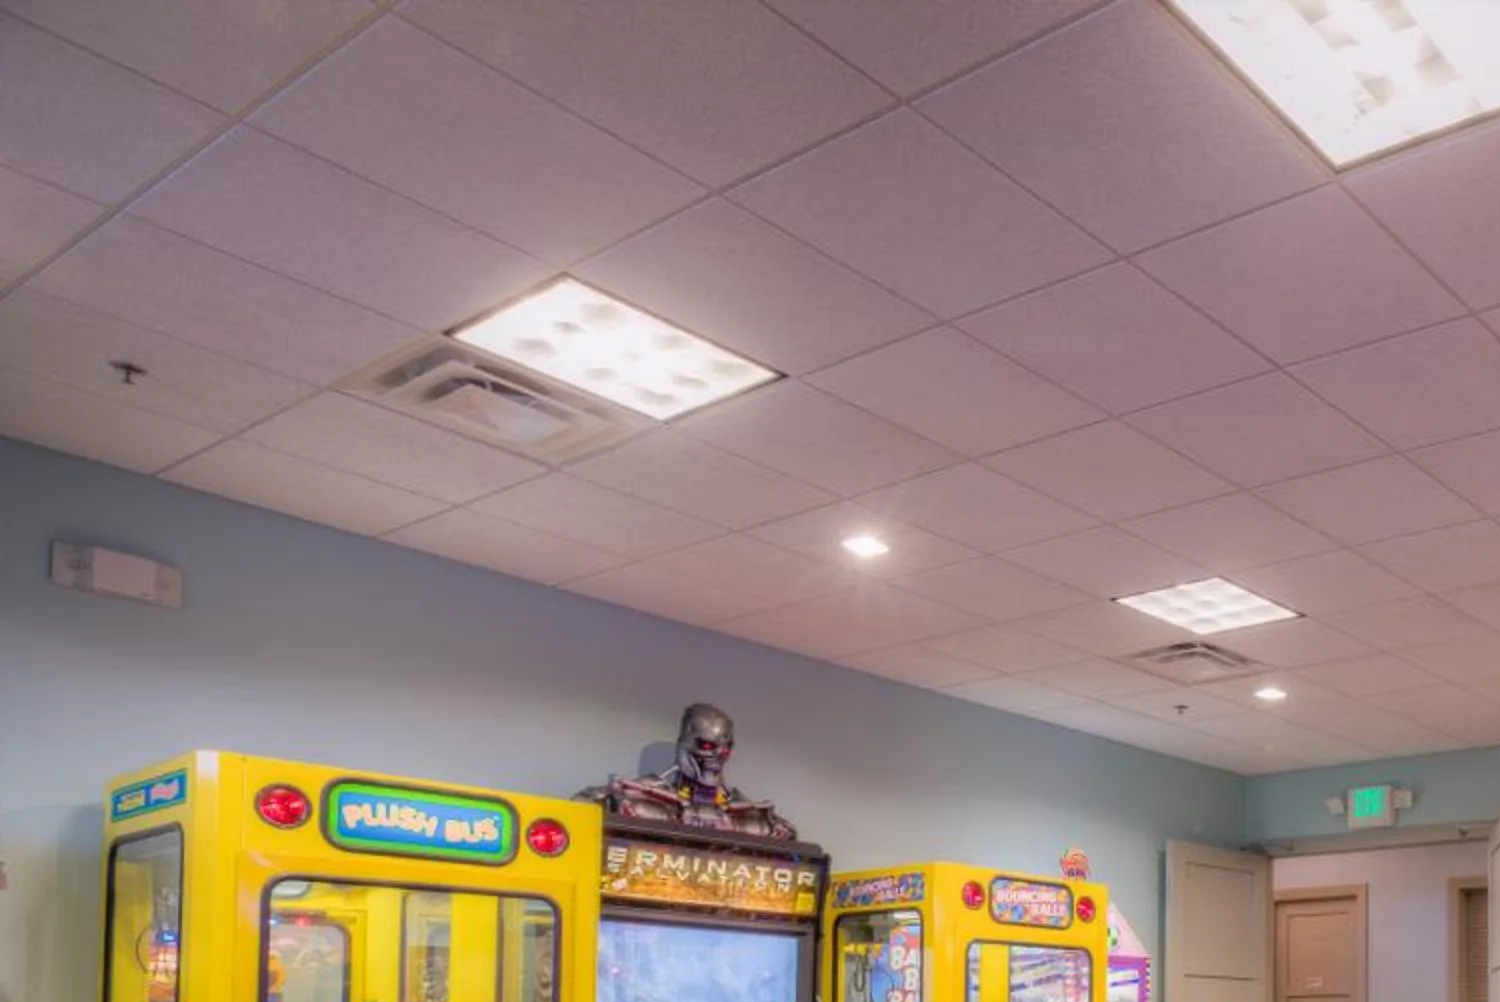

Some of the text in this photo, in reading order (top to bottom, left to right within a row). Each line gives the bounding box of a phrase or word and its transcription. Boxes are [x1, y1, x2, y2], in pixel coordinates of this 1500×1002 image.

[342, 803, 498, 842] PLUSH BUS
[607, 845, 815, 887] ERMINATOR
[607, 862, 791, 892] SALVATION
[995, 888, 1057, 903] BOUNCING
